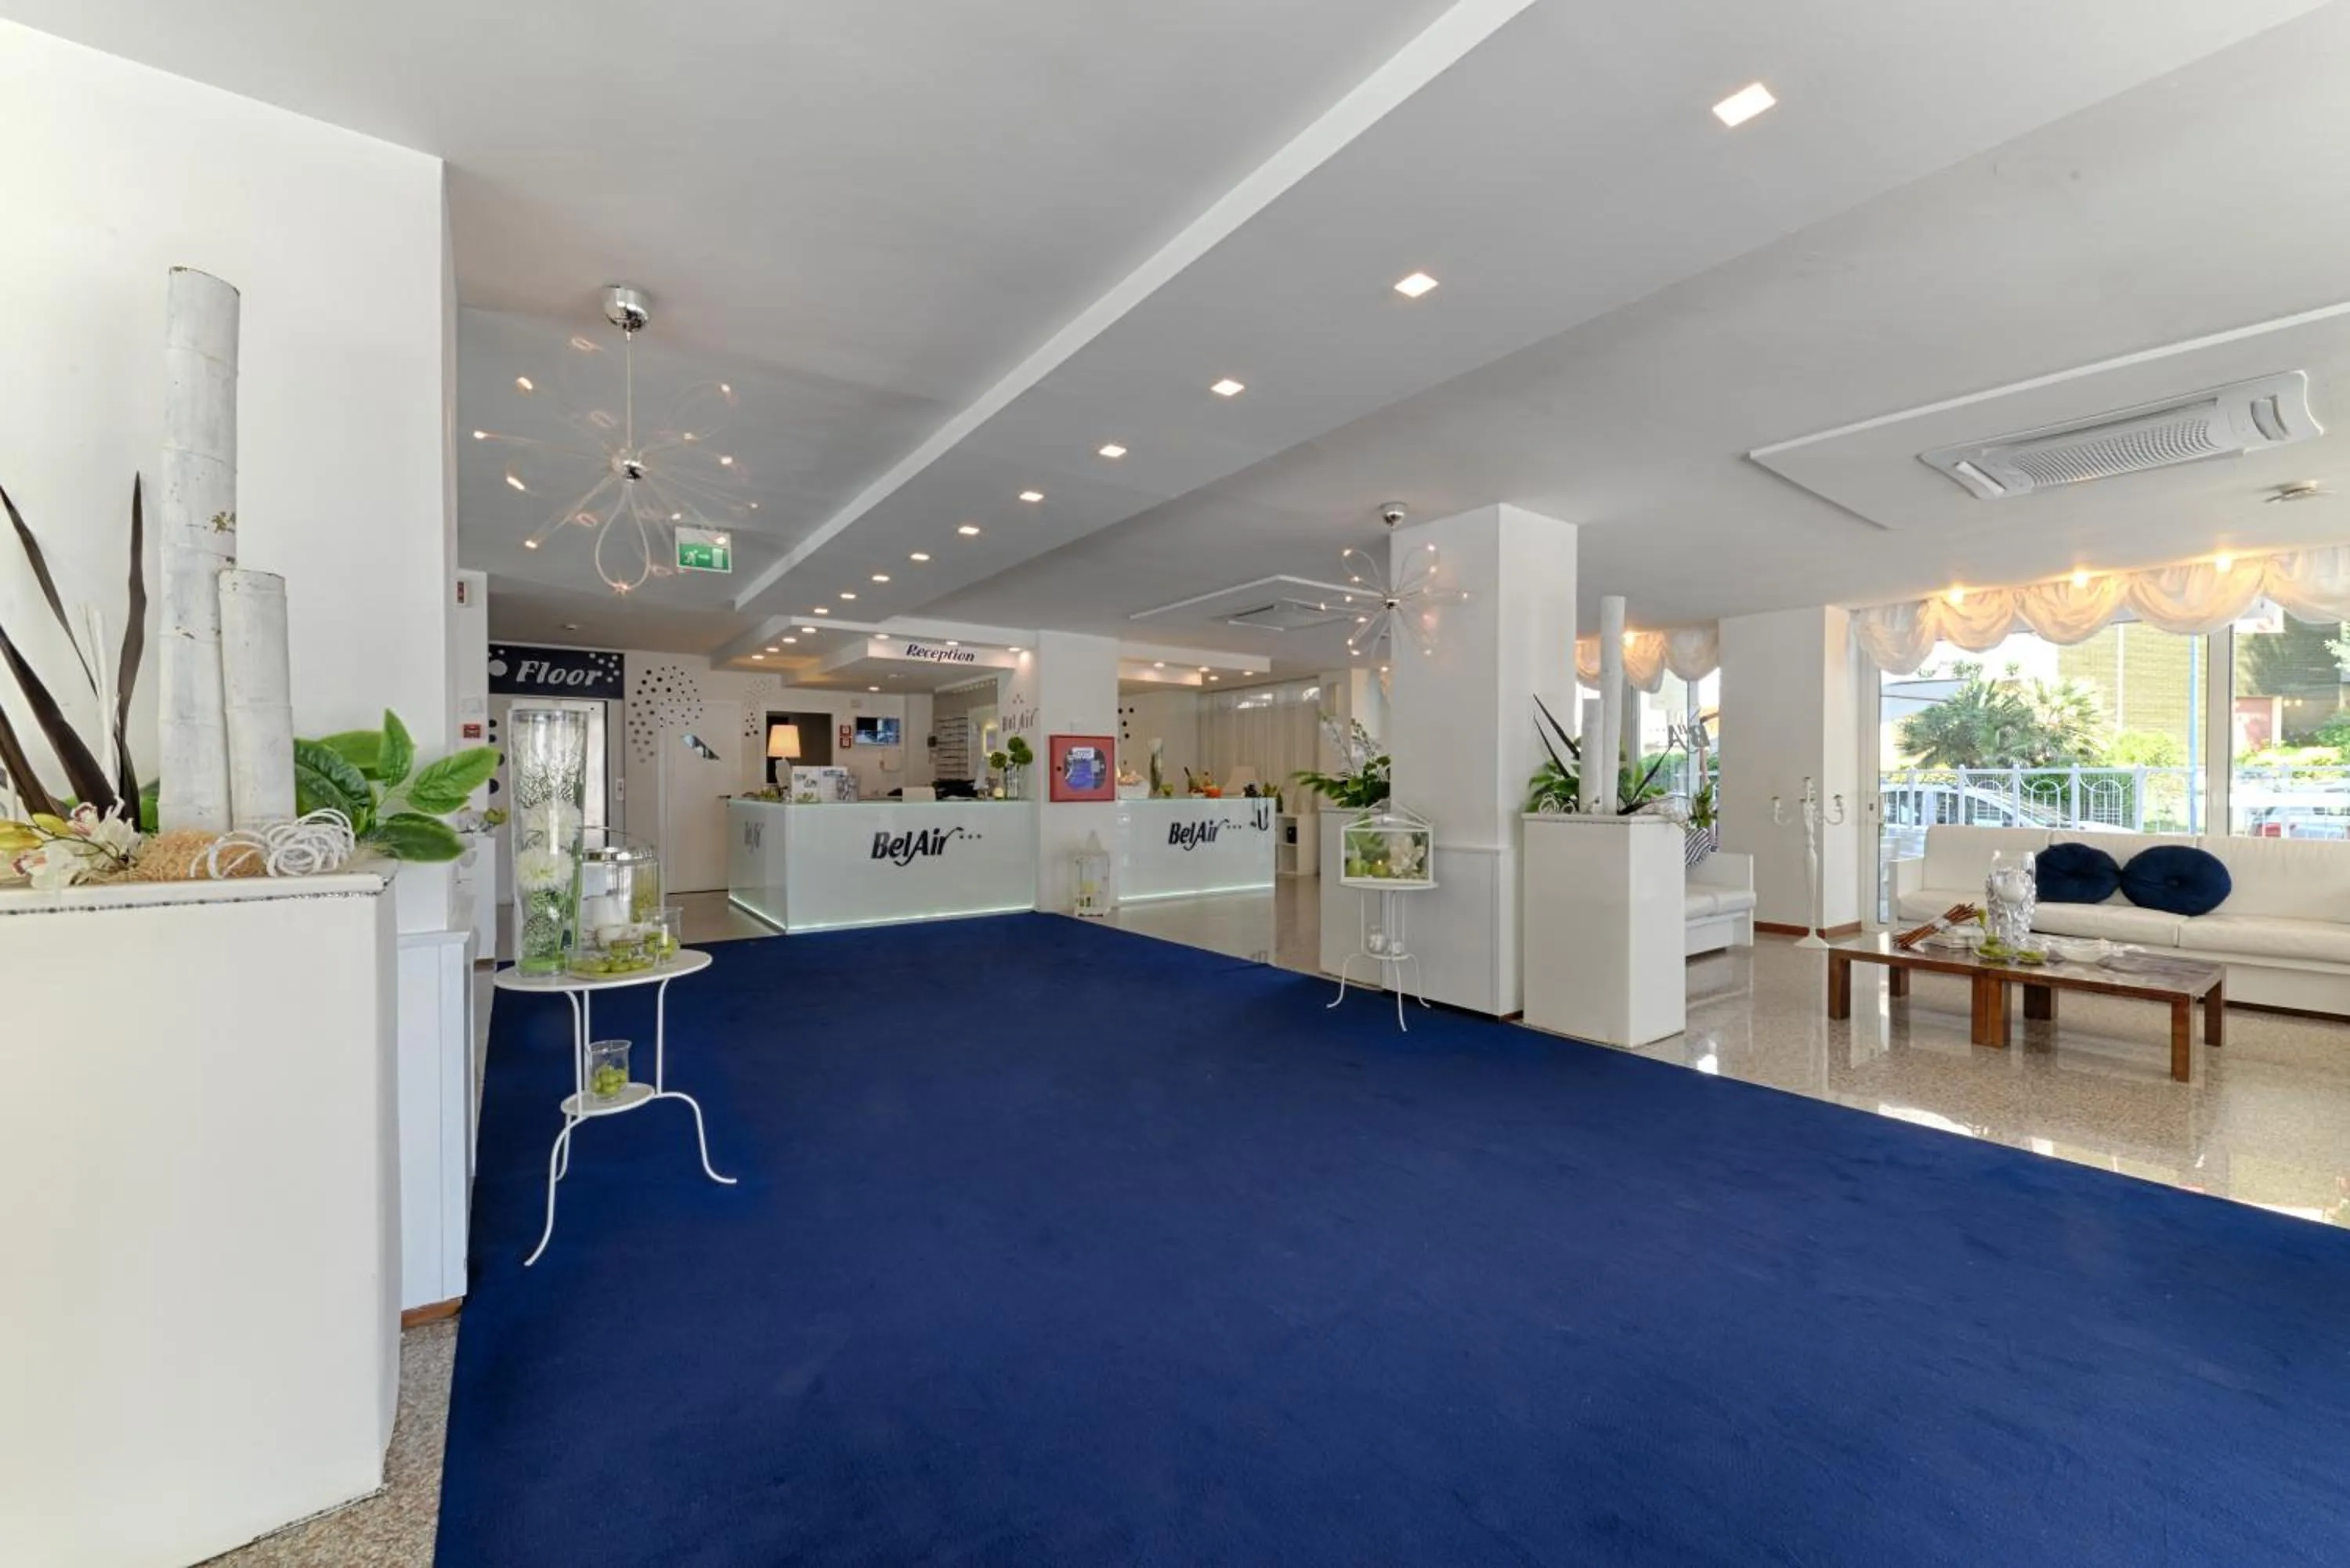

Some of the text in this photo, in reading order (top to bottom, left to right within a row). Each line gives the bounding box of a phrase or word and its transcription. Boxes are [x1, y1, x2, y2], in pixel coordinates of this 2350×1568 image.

[906, 643, 975, 662] Reception
[515, 659, 602, 687] Floor
[870, 826, 964, 867] BelAir
[1167, 818, 1230, 851] BelAir
